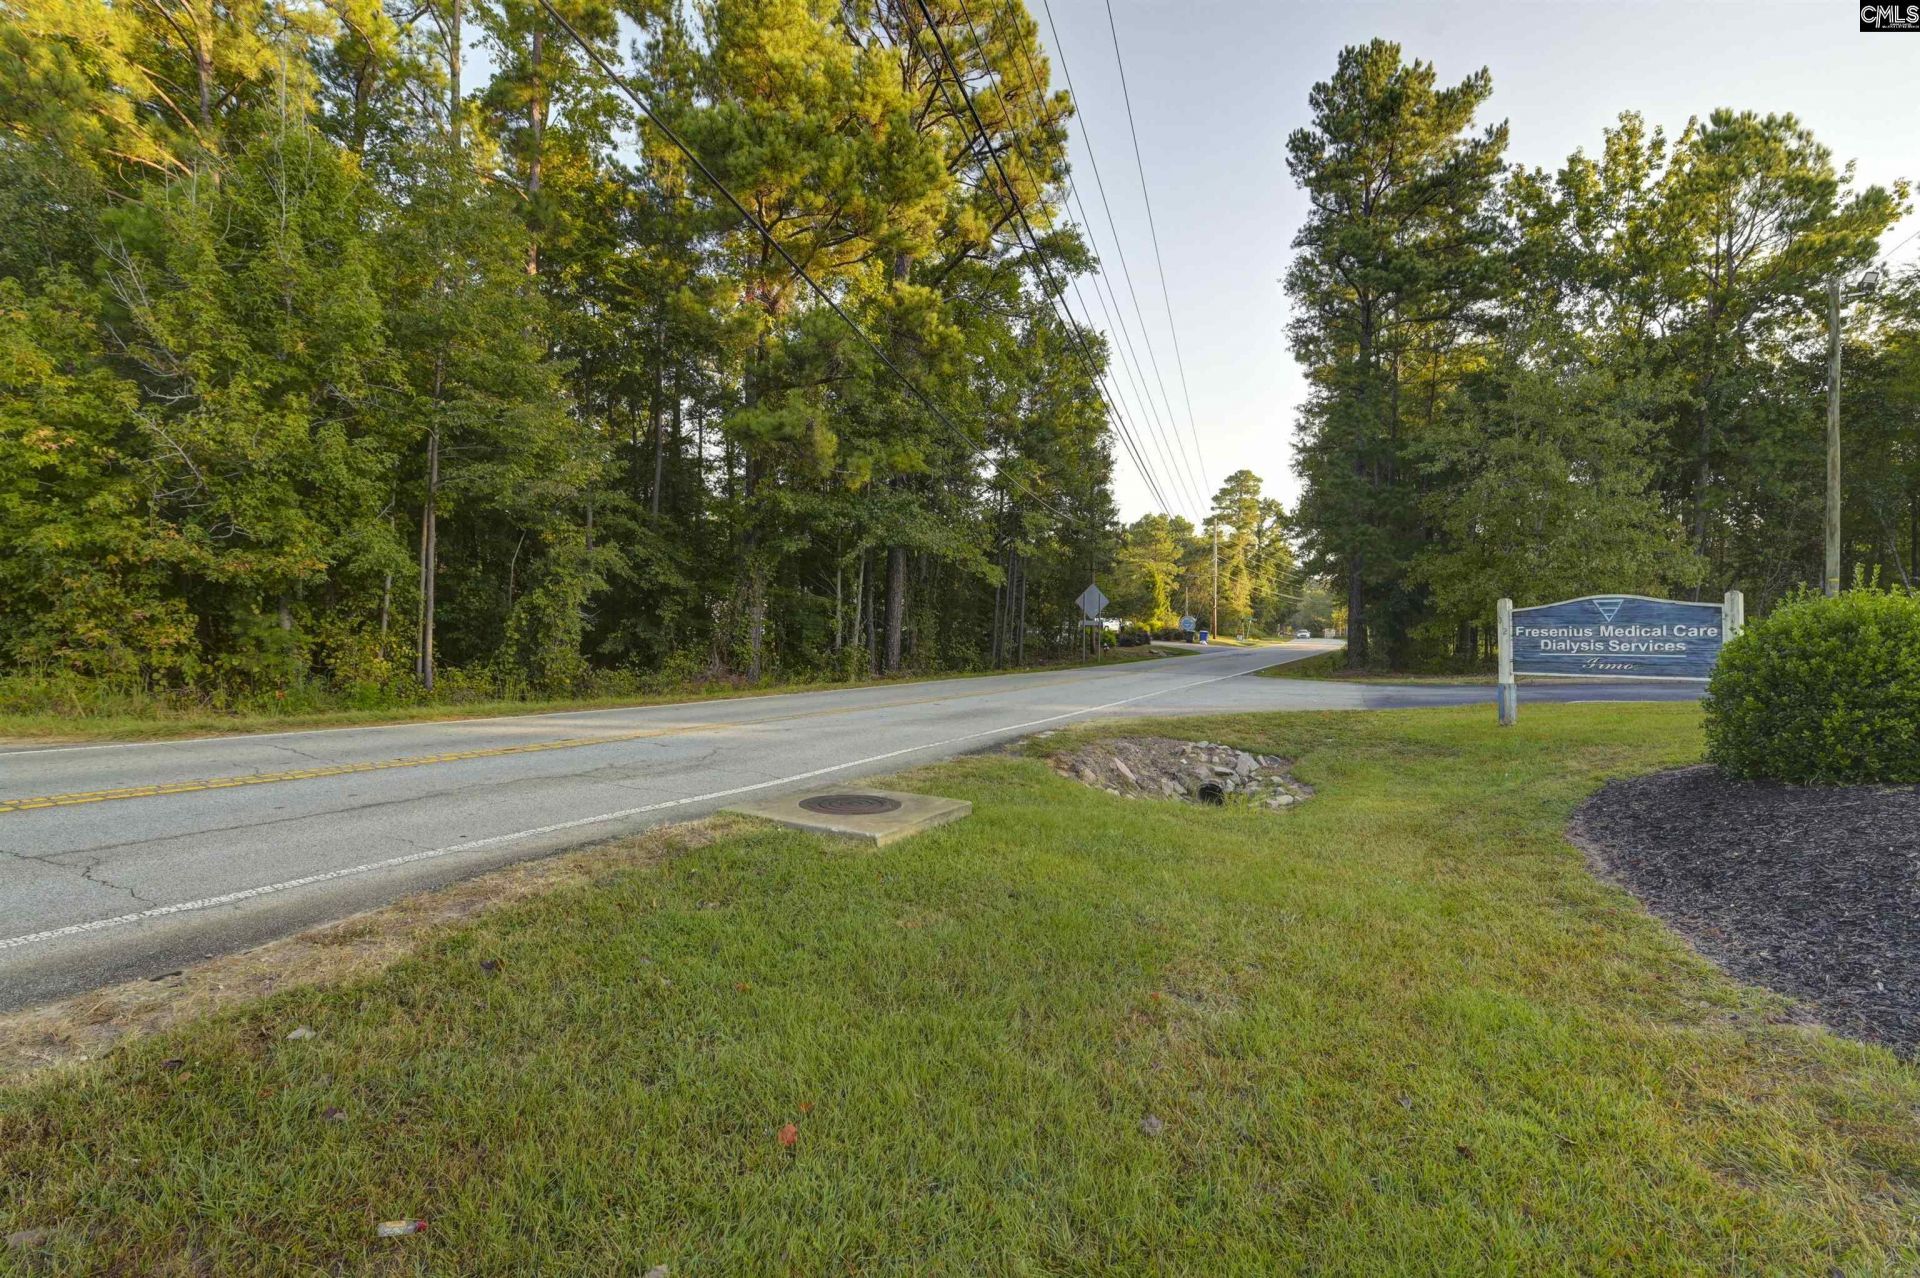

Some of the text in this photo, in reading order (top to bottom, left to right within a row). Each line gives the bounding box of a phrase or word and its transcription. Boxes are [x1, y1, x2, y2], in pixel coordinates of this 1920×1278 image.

[1515, 624, 1719, 638] Fresenius Medical Care
[1540, 639, 1687, 654] Dialysis Services
